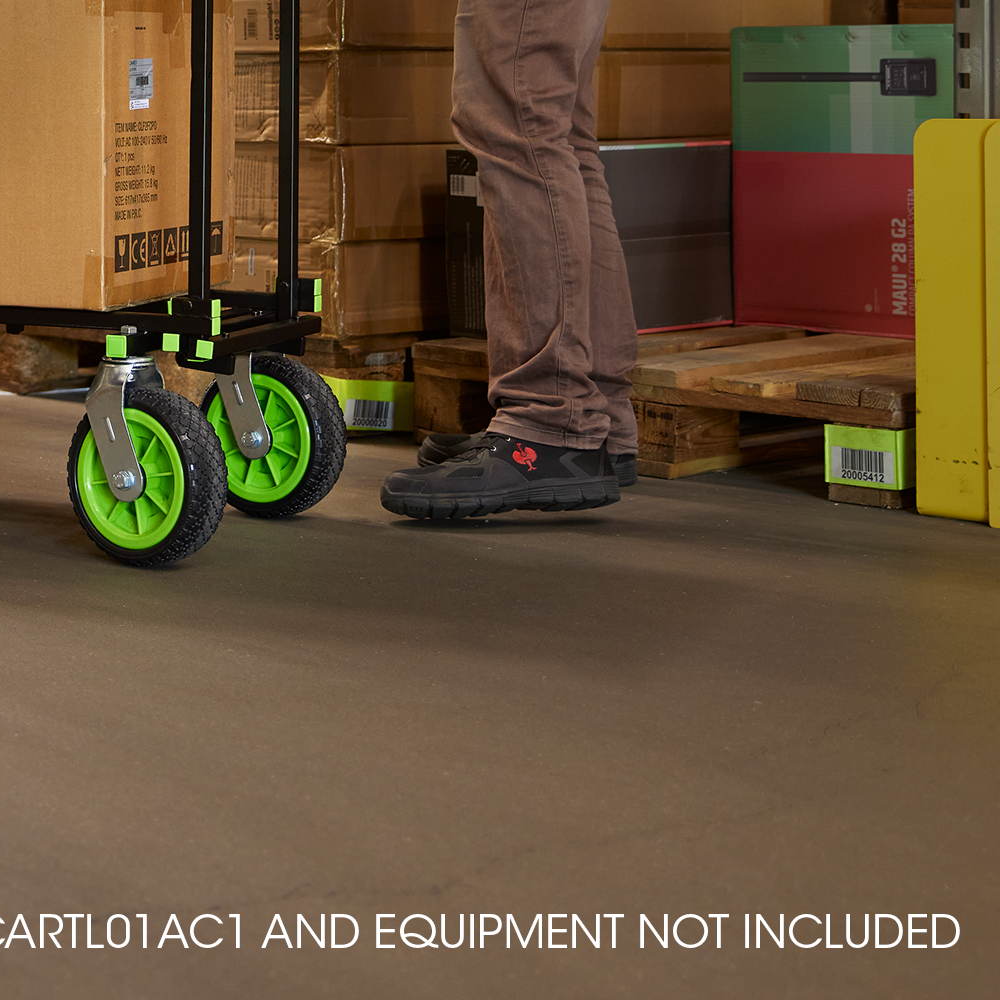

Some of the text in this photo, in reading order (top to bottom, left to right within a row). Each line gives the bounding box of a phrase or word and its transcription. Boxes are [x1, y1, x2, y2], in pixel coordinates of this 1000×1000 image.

[115, 122, 125, 133] ITEM
[115, 166, 125, 177] NETT
[150, 164, 155, 175] kg
[115, 180, 129, 192] GROSS
[153, 178, 158, 190] kg
[150, 193, 158, 202] mm
[115, 209, 126, 221] MADE
[126, 209, 132, 220] IN
[891, 218, 908, 239] G2
[891, 242, 908, 263] 28
[841, 469, 885, 484] 20005412
